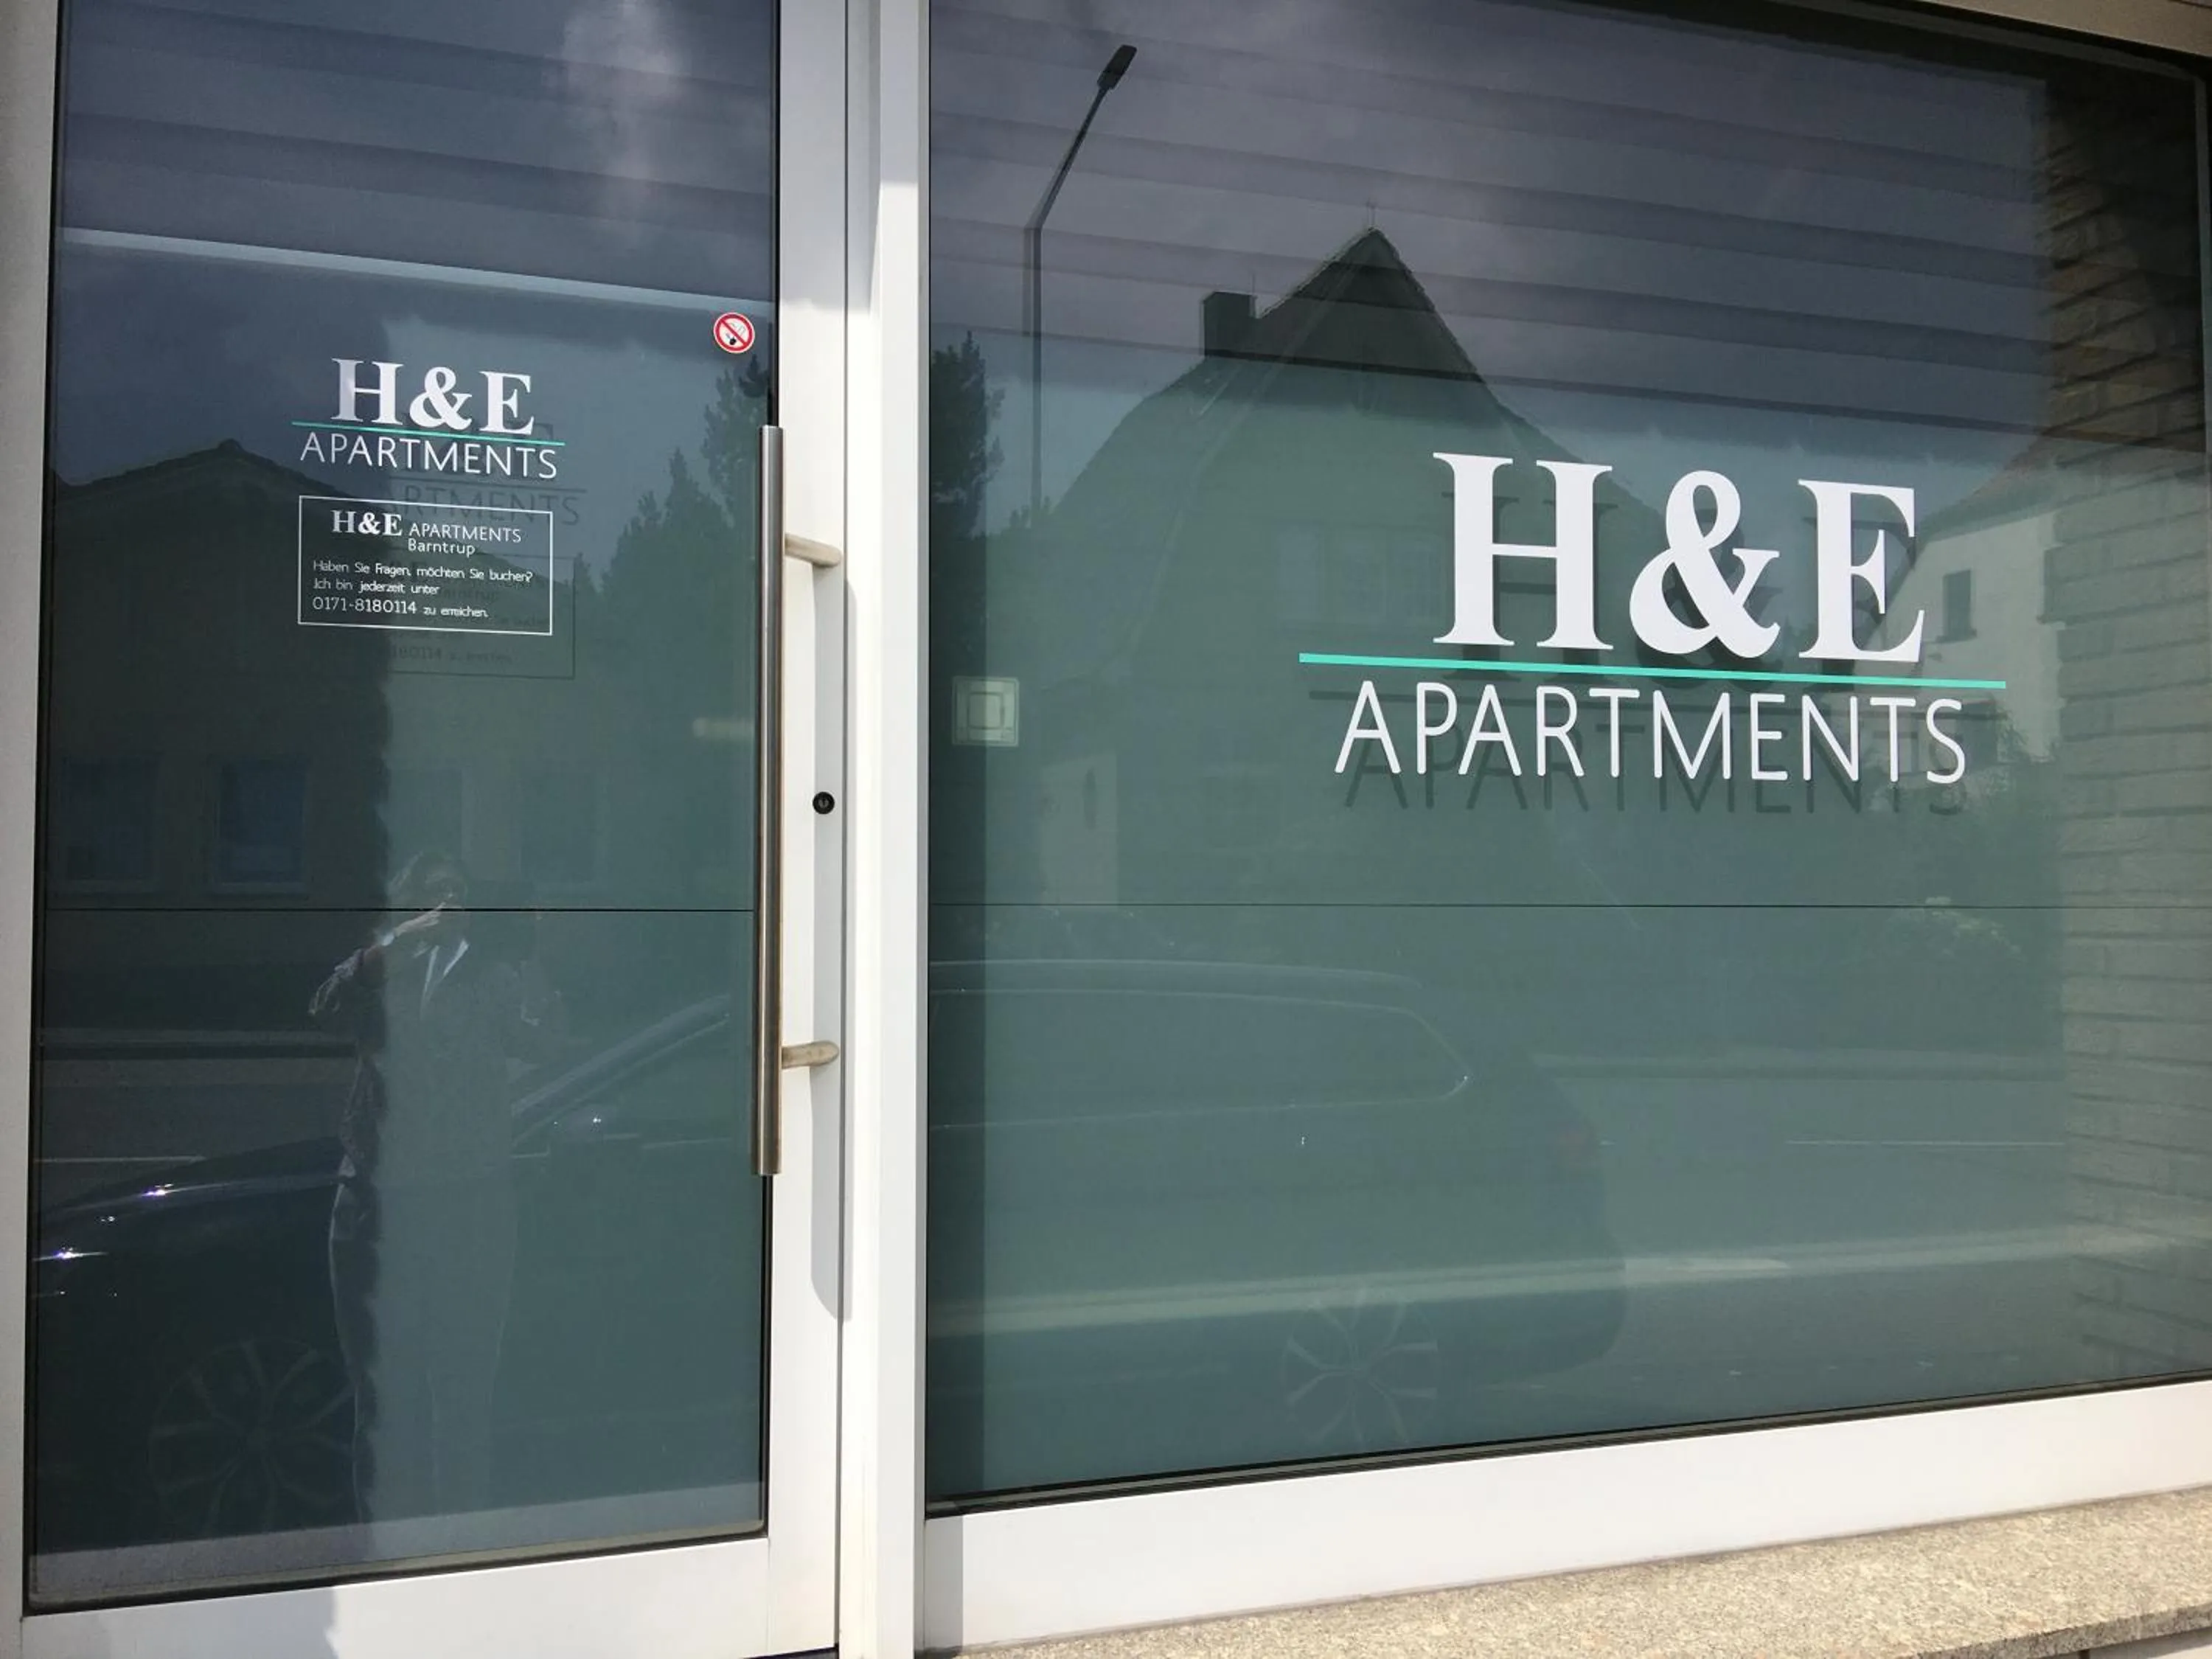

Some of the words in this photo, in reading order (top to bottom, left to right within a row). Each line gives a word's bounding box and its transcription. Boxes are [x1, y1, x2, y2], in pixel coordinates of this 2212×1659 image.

[331, 358, 534, 435] H&E
[300, 431, 557, 479] APARTMENTS
[331, 509, 403, 536] H&E
[408, 522, 521, 543] APARTMENTS
[408, 538, 476, 558] Barntrup
[1433, 452, 1924, 662] H&E
[313, 560, 349, 573] Haben
[355, 562, 369, 574] Sie
[417, 566, 465, 579] möchten
[470, 568, 484, 580] Sie
[489, 569, 533, 583] buchen?
[313, 578, 331, 589] Ich
[336, 578, 353, 590] bin
[358, 580, 406, 594] jederzeit
[411, 585, 440, 595] unter
[313, 597, 417, 614] 0171-8180114
[423, 607, 437, 616] zu
[1335, 680, 1966, 784] APARTMENTS
